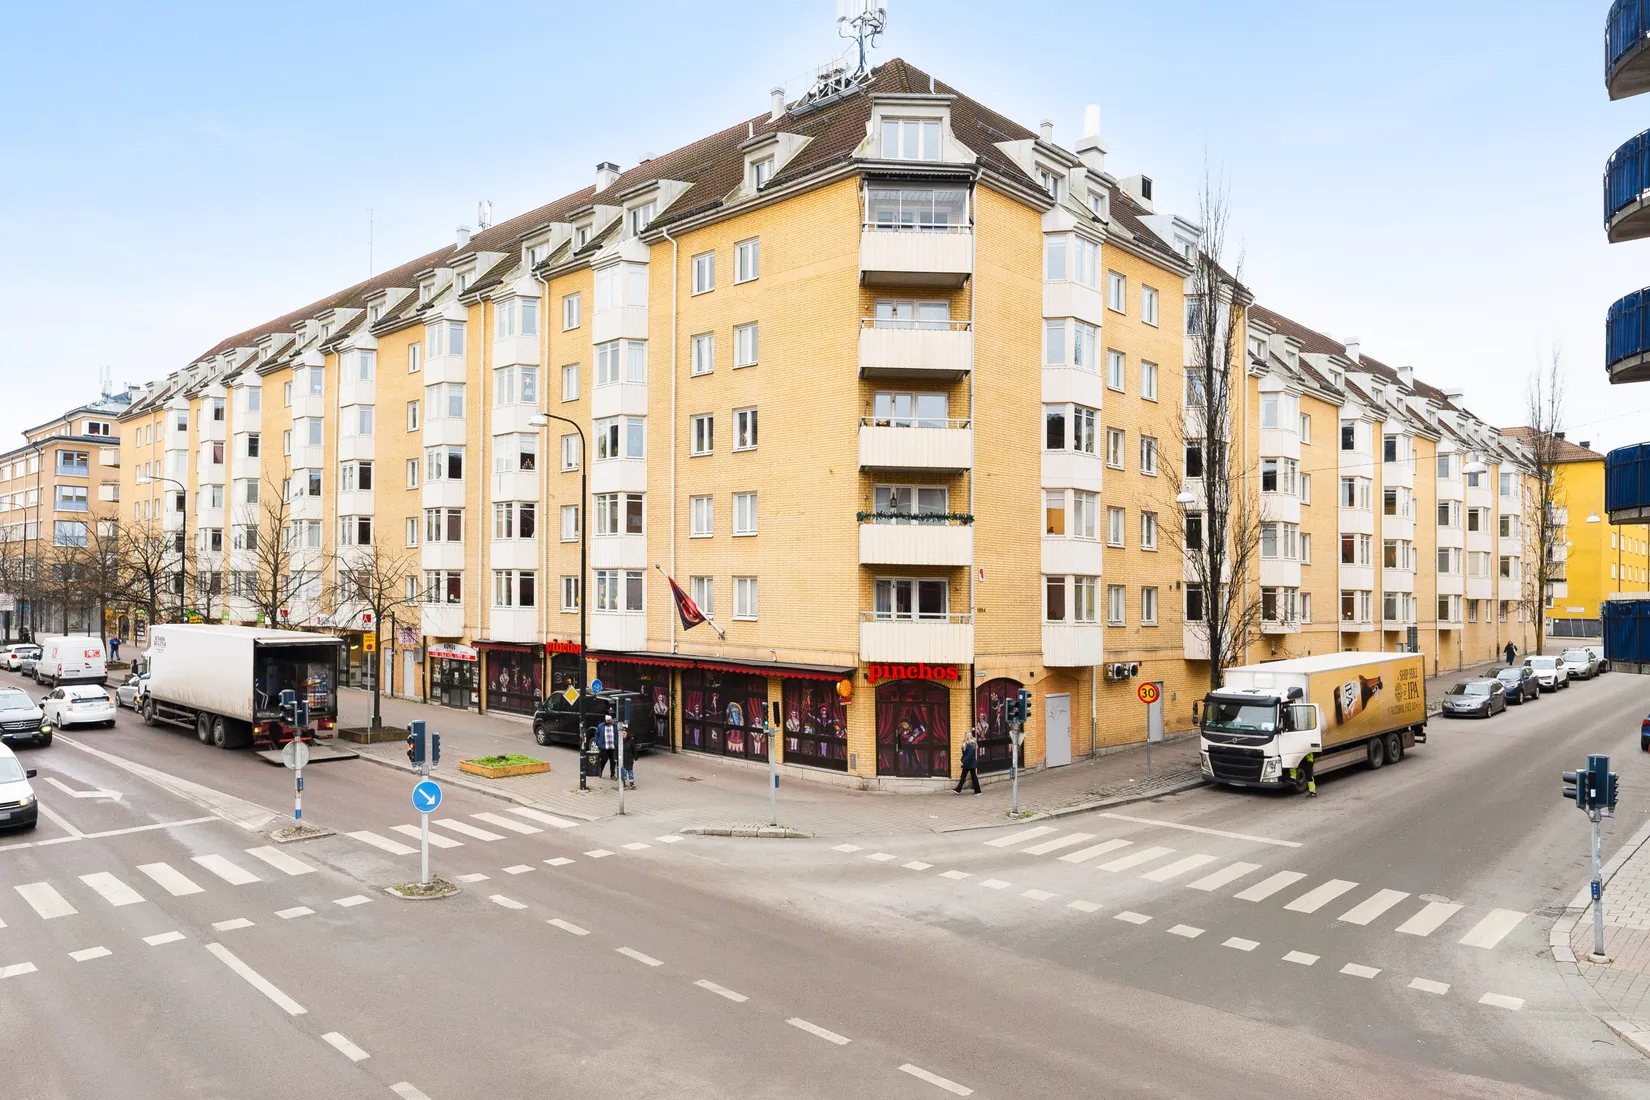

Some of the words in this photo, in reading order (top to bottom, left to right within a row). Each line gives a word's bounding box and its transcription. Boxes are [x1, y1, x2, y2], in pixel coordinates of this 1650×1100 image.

[868, 661, 959, 683] pinchos
[1399, 669, 1409, 681] SHIP
[1409, 667, 1418, 679] FULL
[1141, 688, 1155, 698] 30
[1344, 682, 1354, 708] IPA
[1407, 681, 1420, 700] IPA
